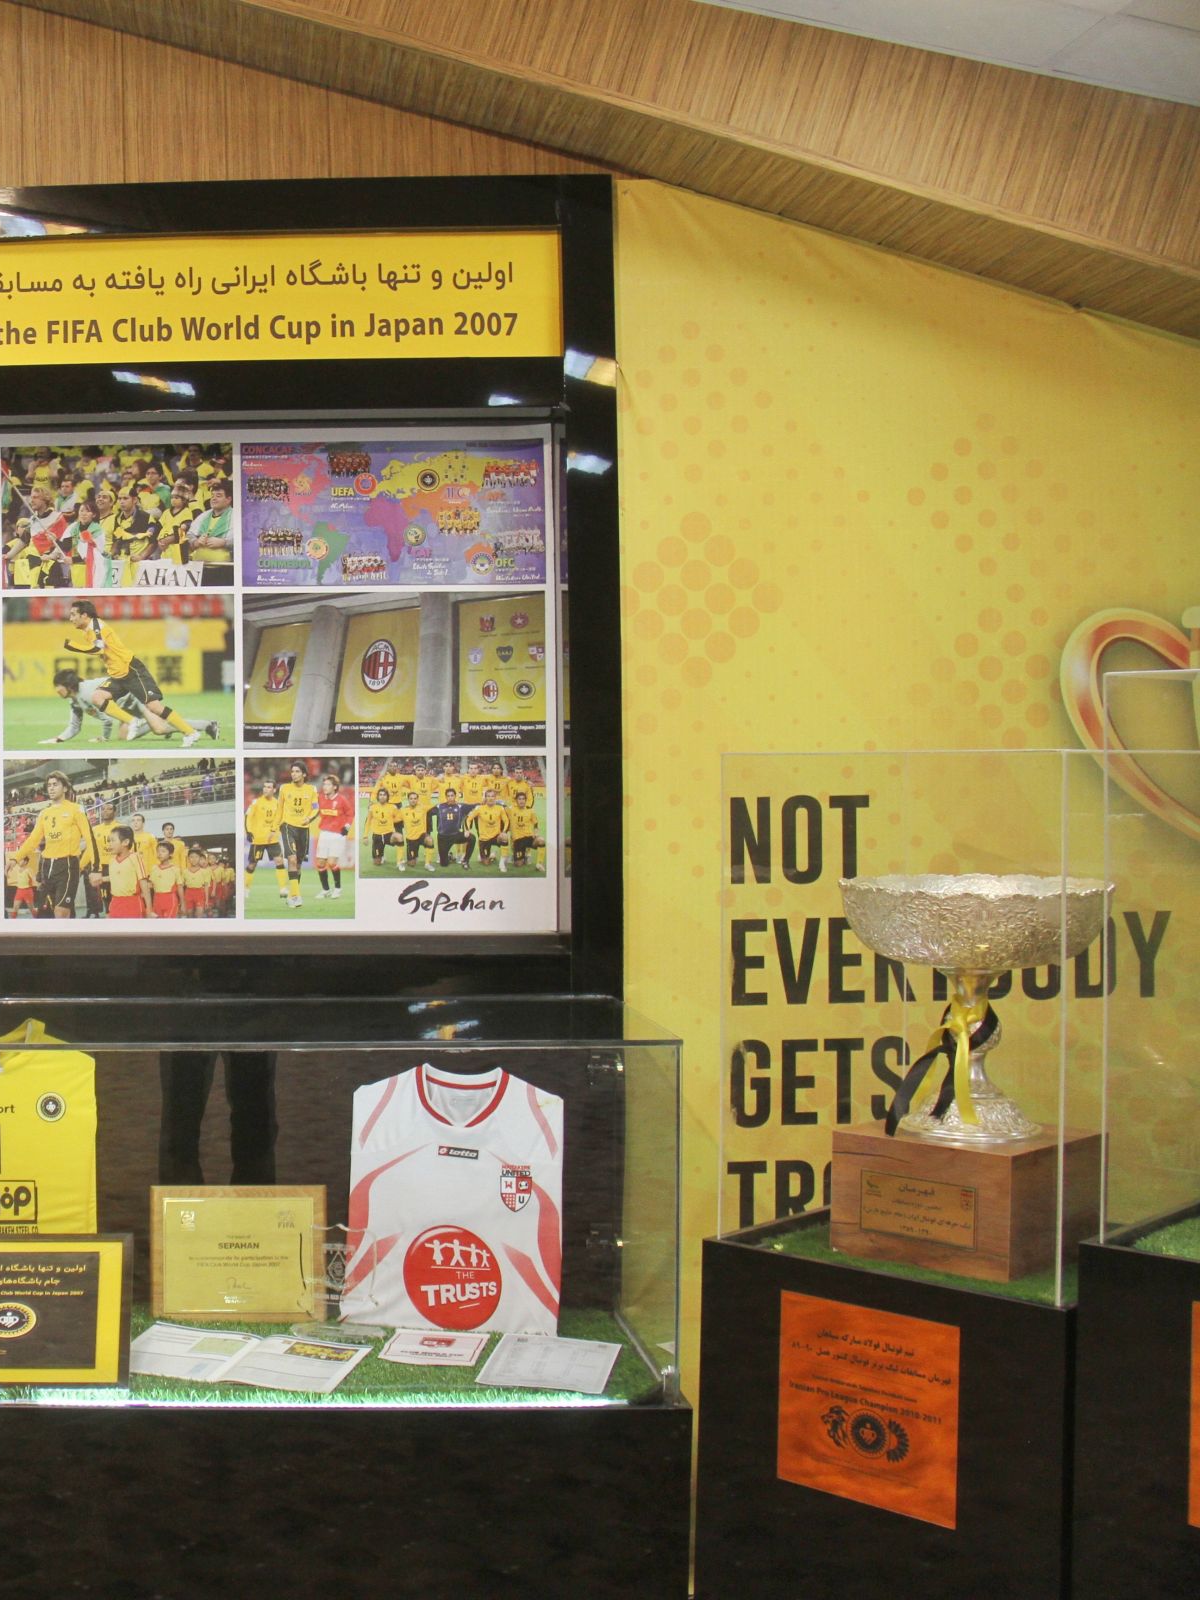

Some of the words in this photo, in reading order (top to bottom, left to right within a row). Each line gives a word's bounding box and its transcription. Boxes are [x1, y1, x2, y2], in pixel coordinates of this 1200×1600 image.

[73, 274, 95, 297] به
[105, 268, 164, 295] یافته
[175, 267, 201, 295] راه
[212, 265, 274, 294] ایرانی
[287, 260, 366, 291] باشگاه
[378, 263, 420, 291] تنها
[432, 270, 442, 290] و
[453, 262, 512, 290] اولین
[48, 320, 102, 343] FIFA
[113, 317, 172, 342] Club
[181, 315, 259, 341] World
[270, 315, 320, 344] Cup
[331, 314, 354, 337] in
[365, 313, 443, 342] Japan
[455, 312, 517, 336] 2007
[730, 795, 869, 885] NOT
[398, 880, 505, 922] Sepahan
[730, 1036, 910, 1128] GETS
[449, 1148, 477, 1158] lotto
[6, 1264, 34, 1272] باشگاه
[64, 1264, 86, 1272] اولین
[456, 1272, 475, 1280] THE
[44, 1278, 60, 1286] جام
[420, 1281, 497, 1306] TRUSTS
